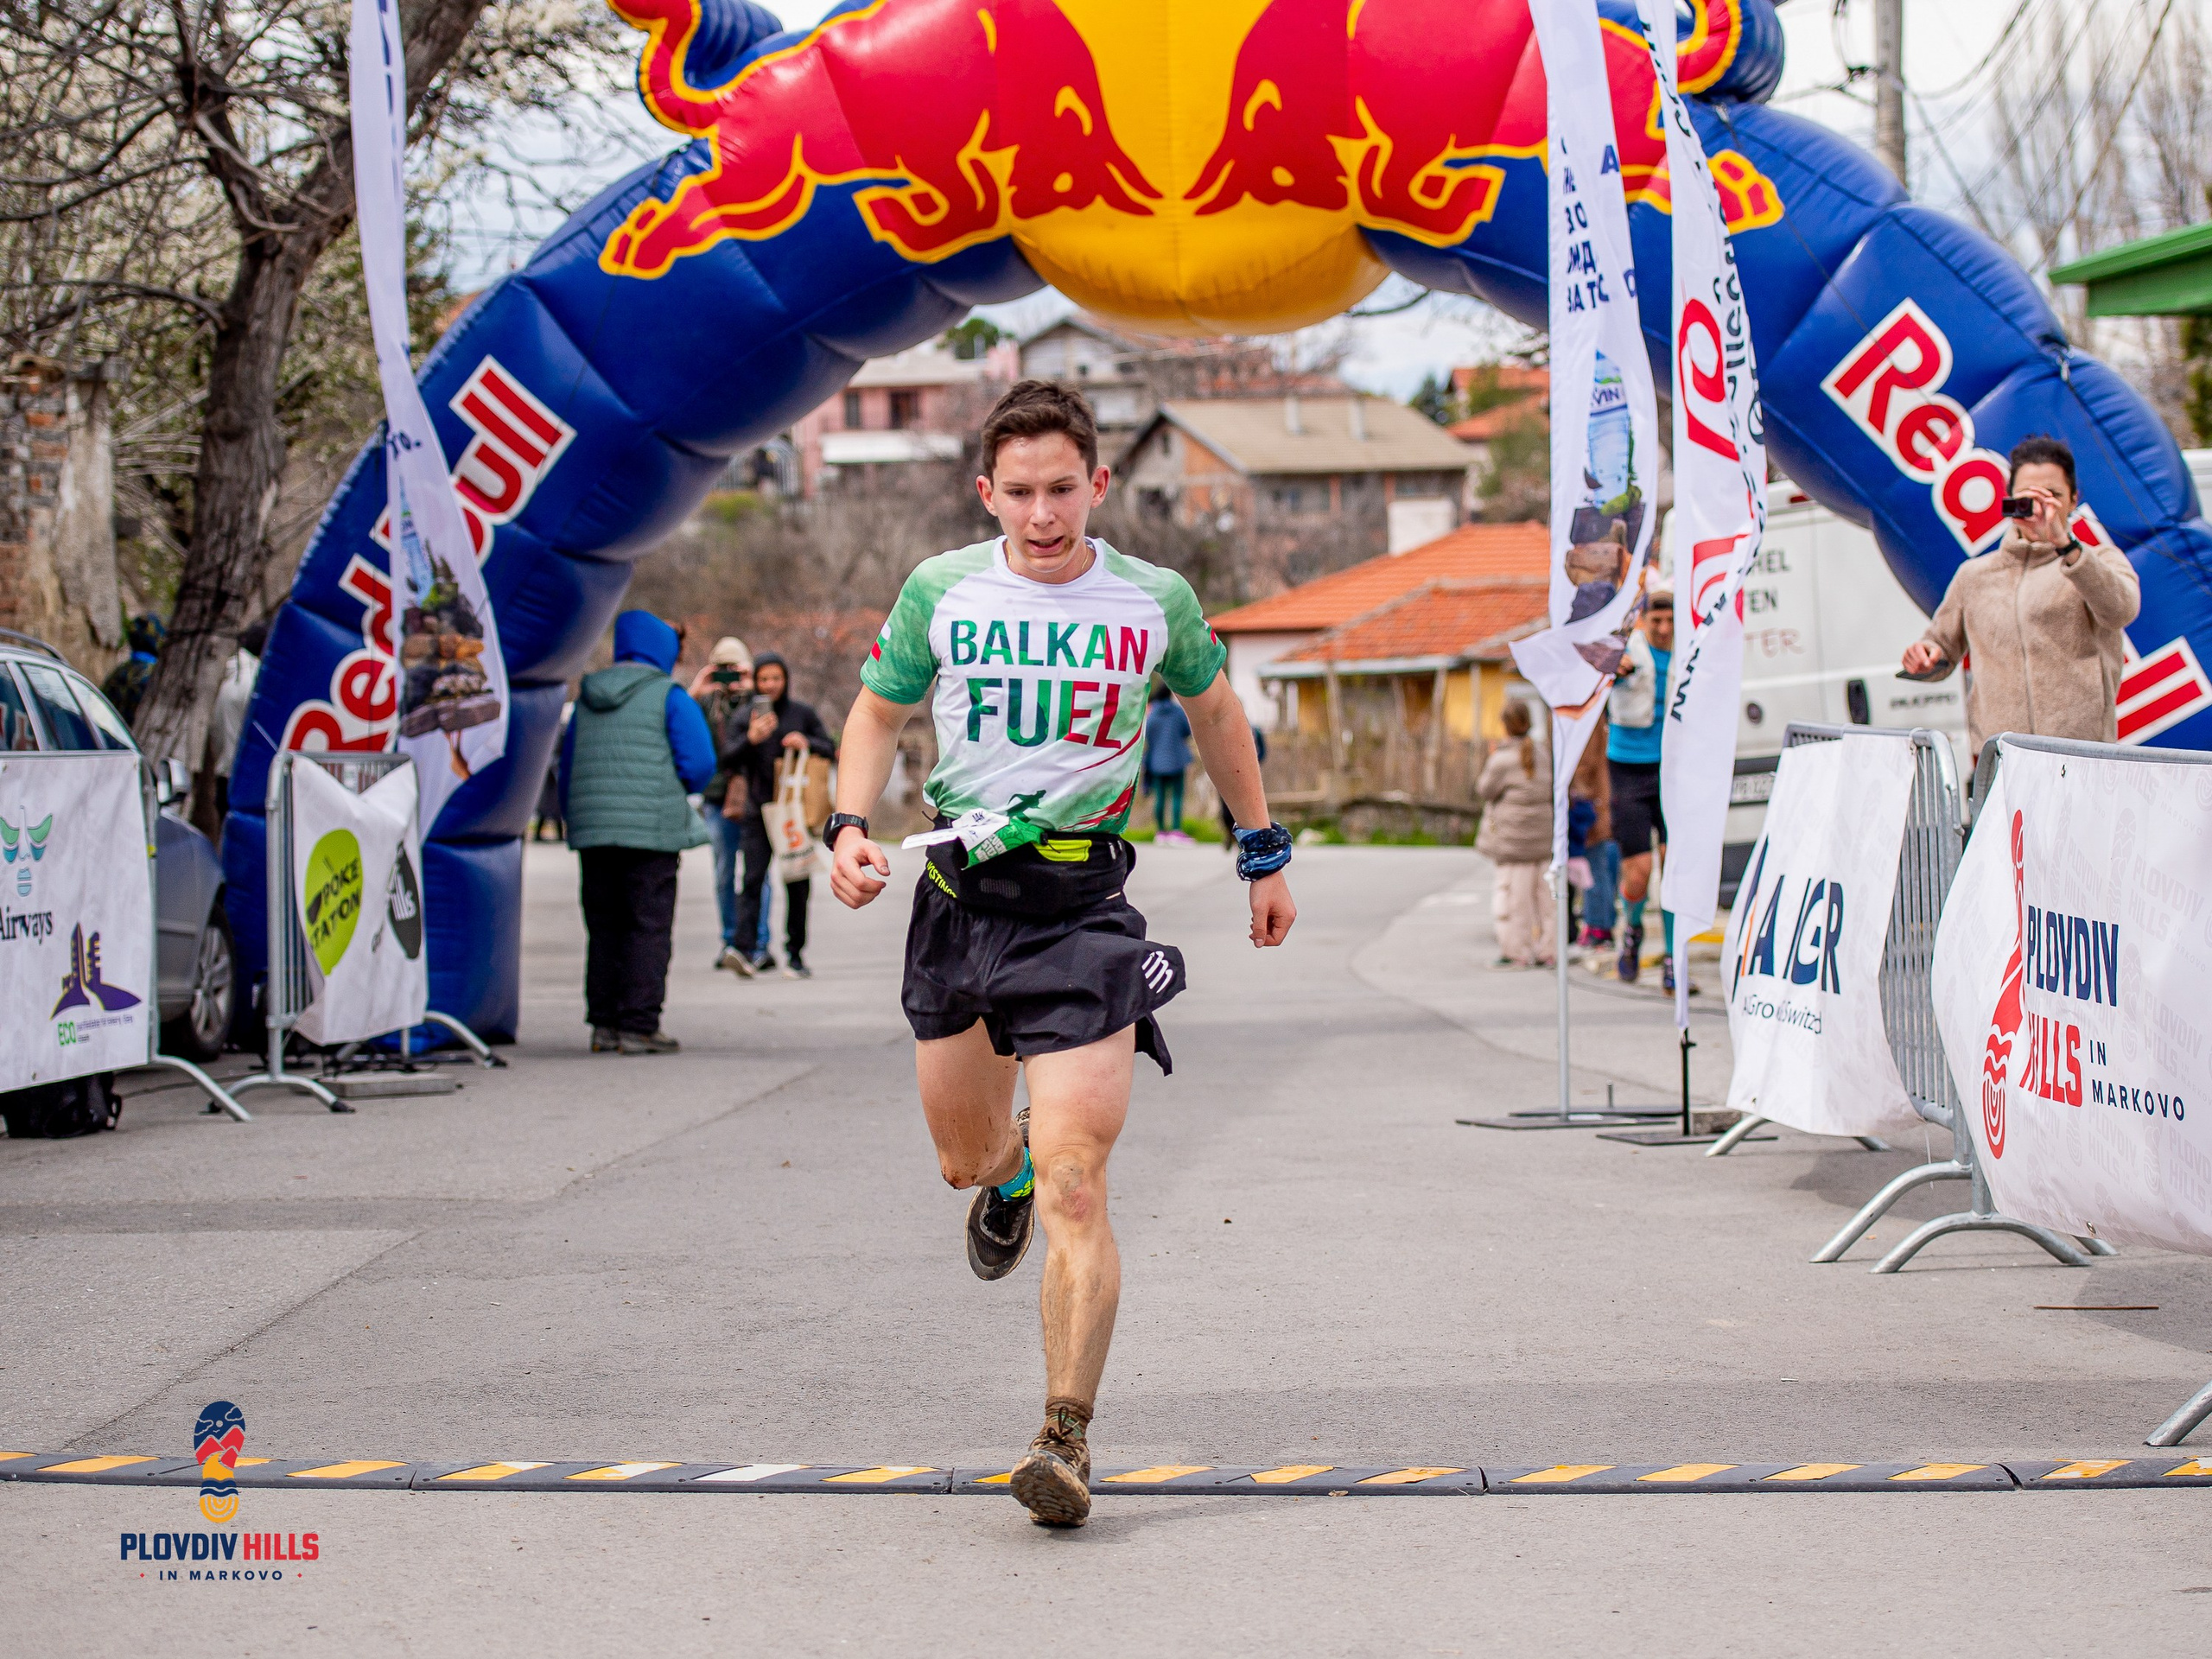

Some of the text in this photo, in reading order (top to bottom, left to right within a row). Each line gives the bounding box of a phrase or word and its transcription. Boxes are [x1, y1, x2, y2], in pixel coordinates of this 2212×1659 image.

[950, 620, 1148, 676] BALKAN
[966, 677, 1123, 750] FUEL
[2027, 905, 2120, 1007] PLOVDIV
[2018, 1010, 2083, 1108] HILLS
[2089, 1039, 2107, 1066] IN
[2091, 1078, 2185, 1122] MARKOVO
